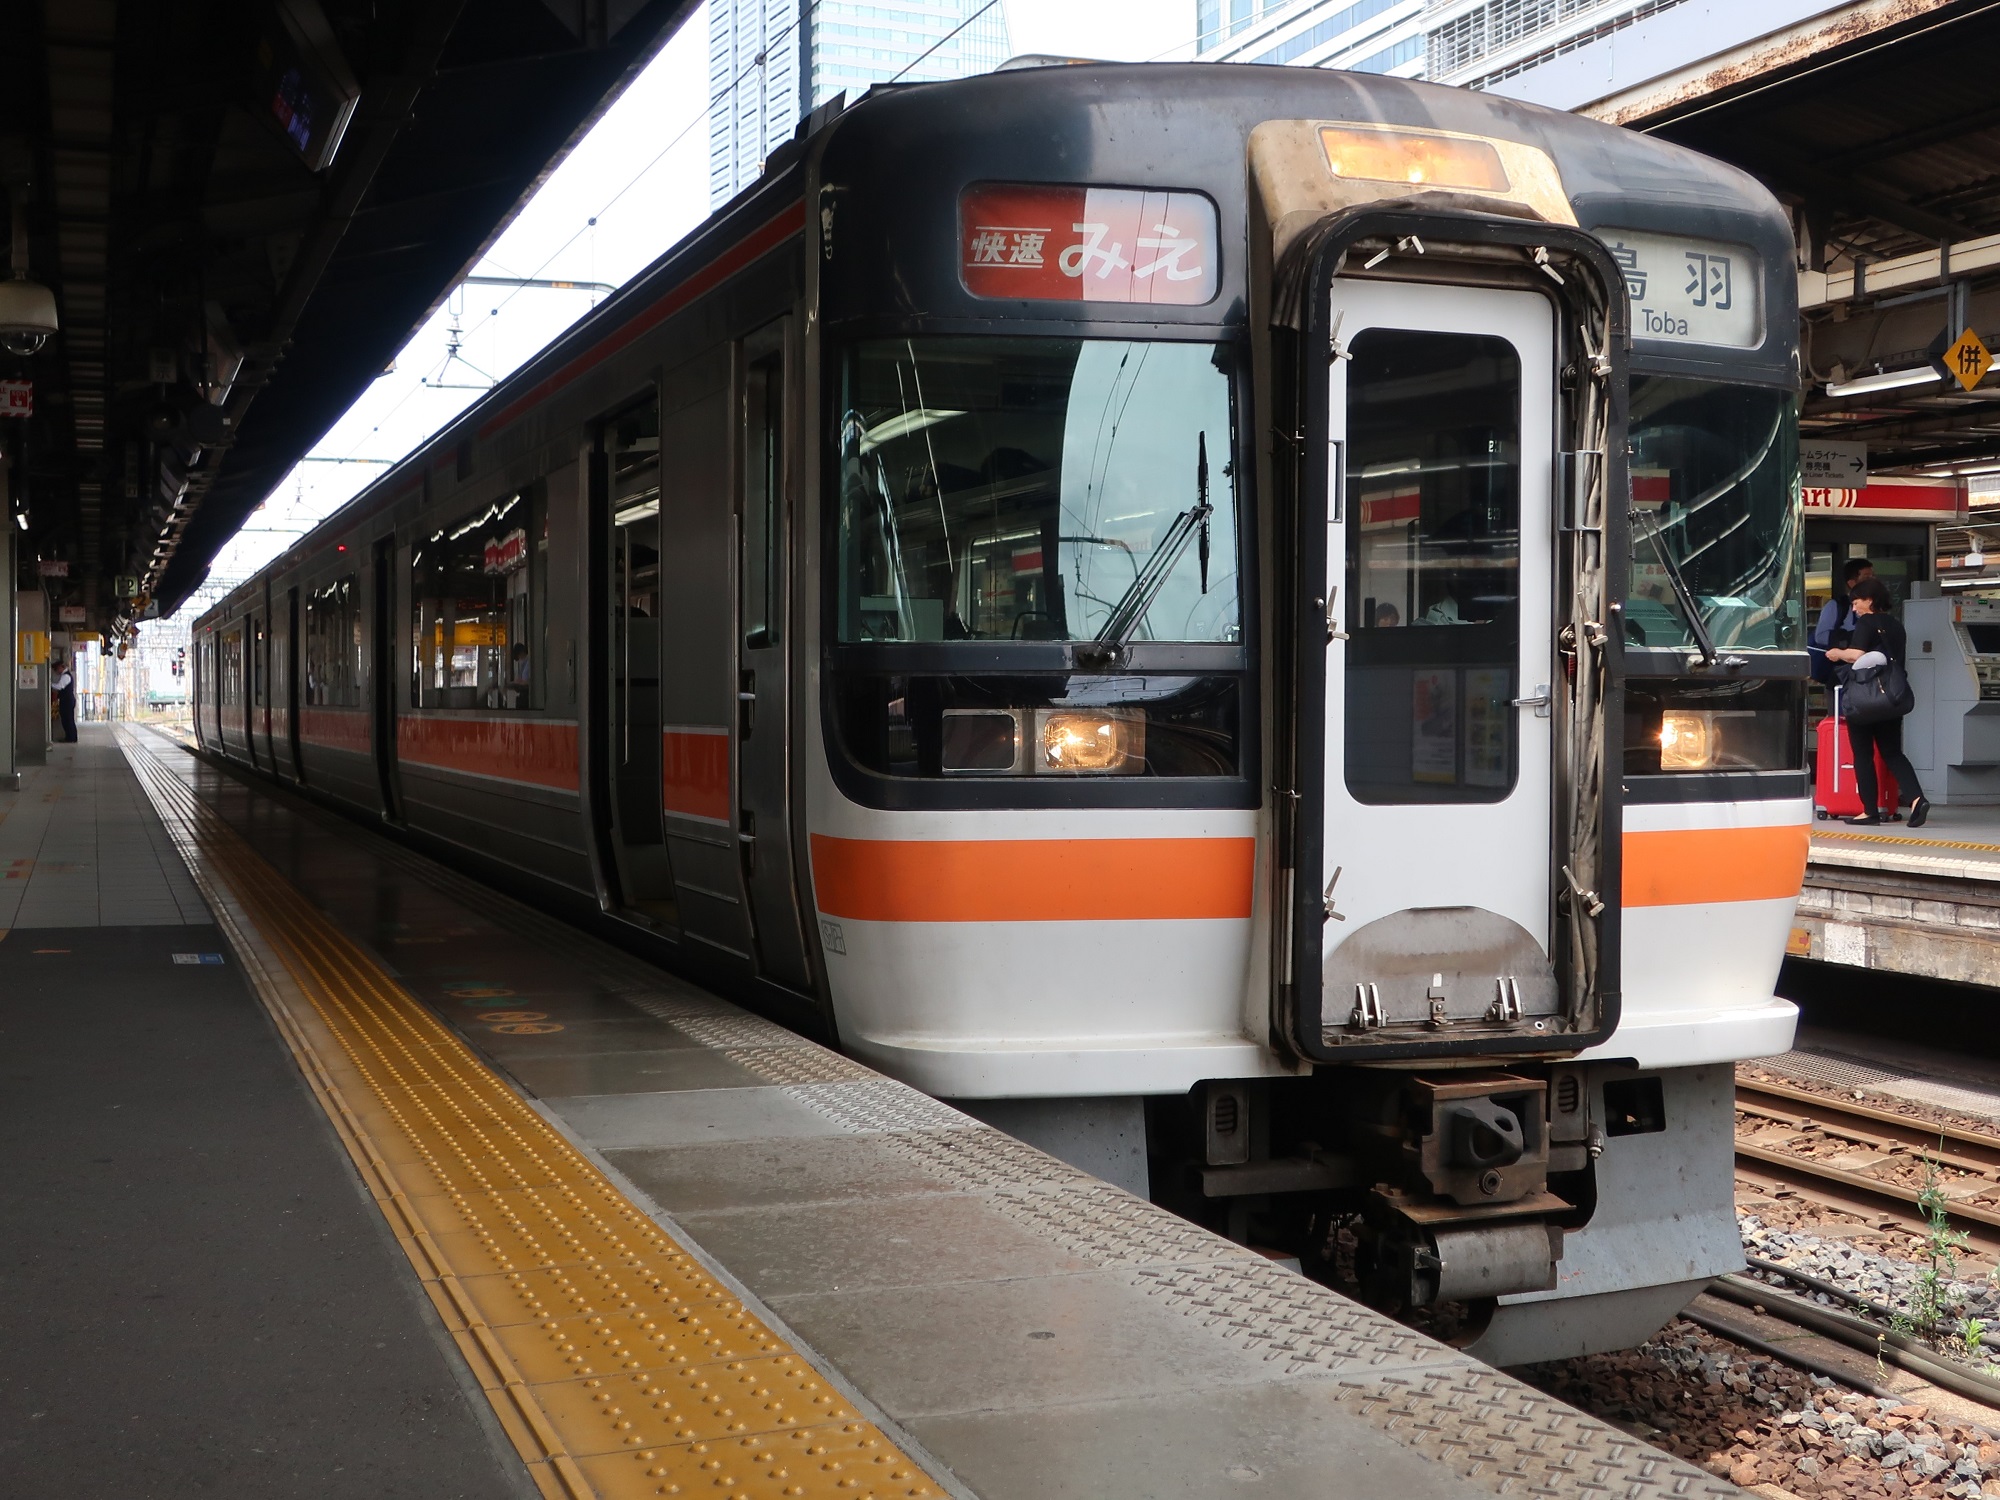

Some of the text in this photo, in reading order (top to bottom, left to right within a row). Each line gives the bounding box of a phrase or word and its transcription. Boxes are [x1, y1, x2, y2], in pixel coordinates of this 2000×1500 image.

[970, 222, 1203, 282] 快速 みえ
[1641, 308, 1689, 336] Toba
[1956, 344, 1982, 376] 併
